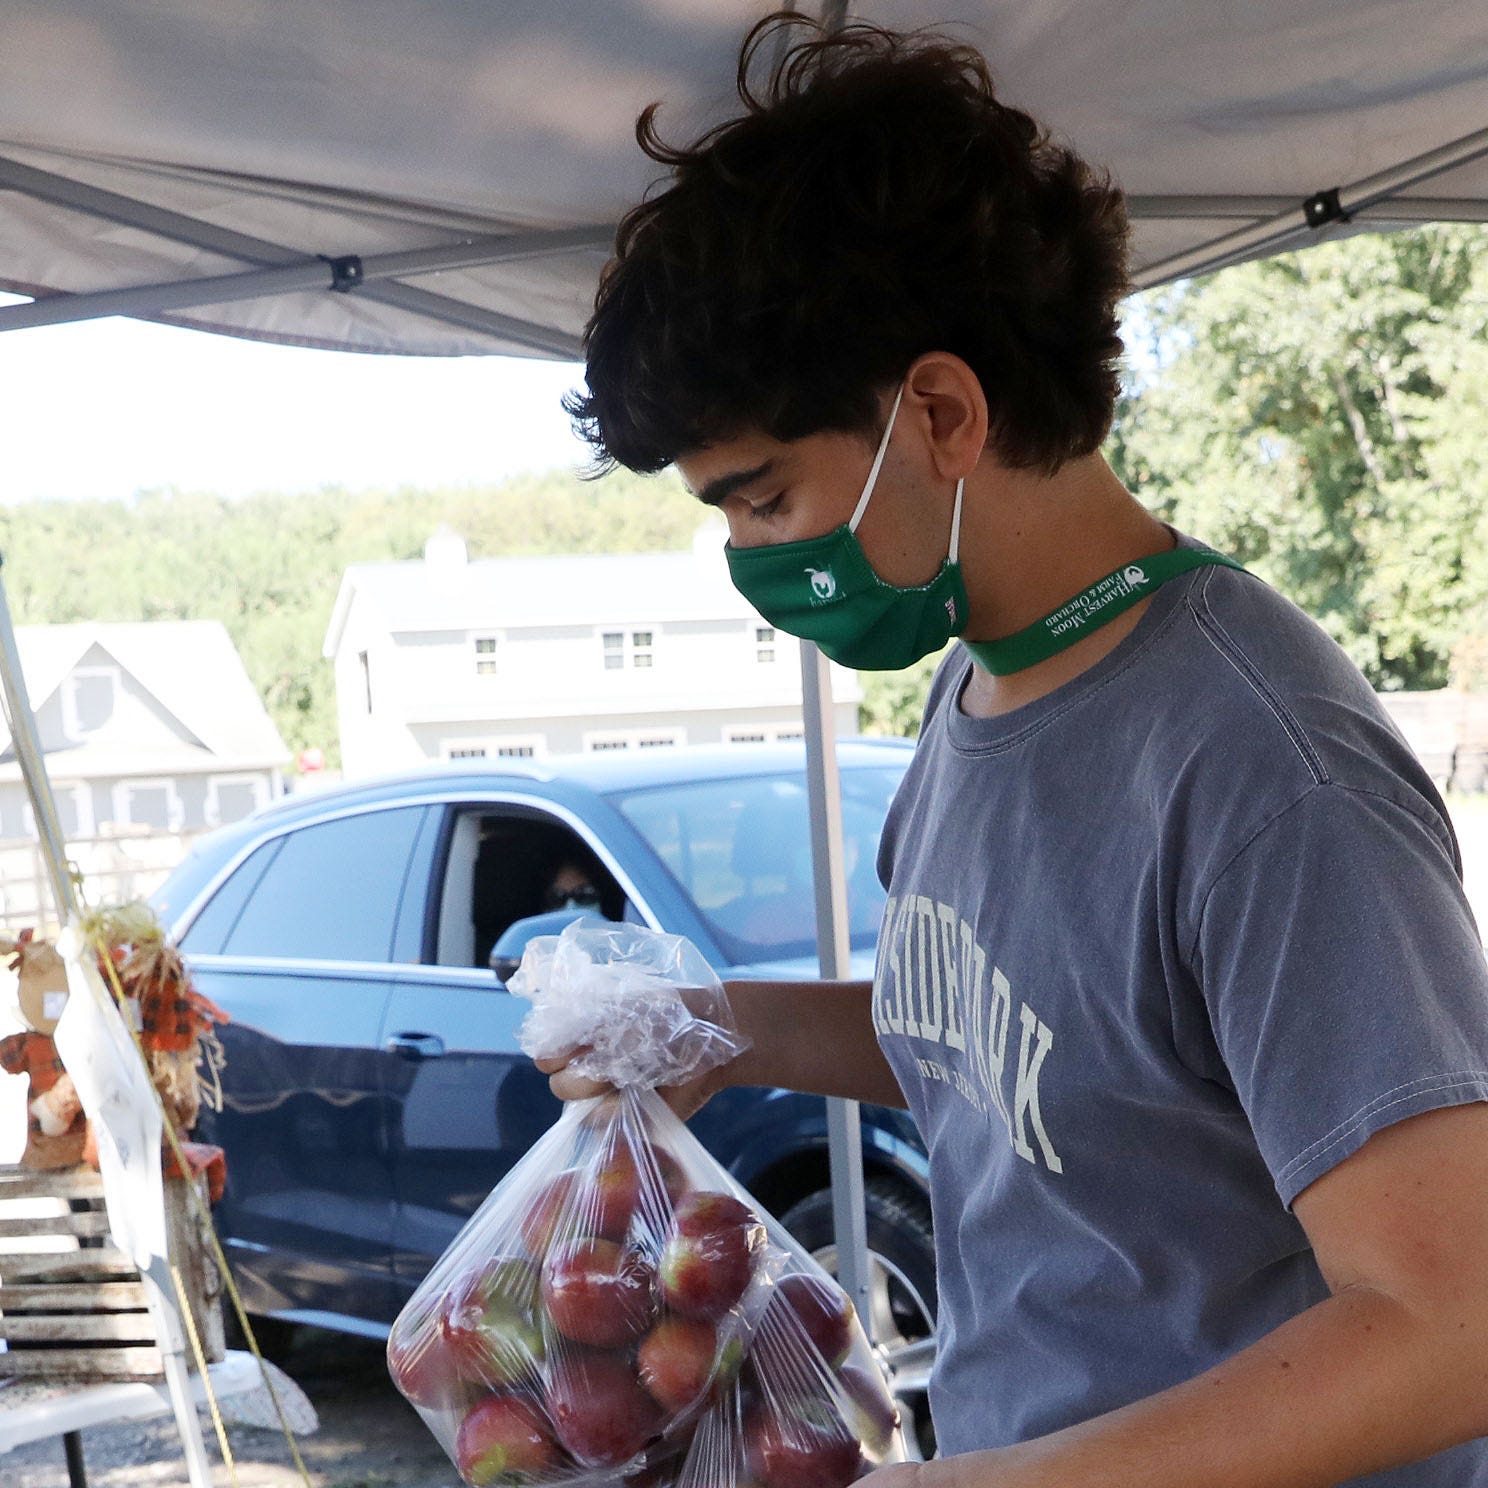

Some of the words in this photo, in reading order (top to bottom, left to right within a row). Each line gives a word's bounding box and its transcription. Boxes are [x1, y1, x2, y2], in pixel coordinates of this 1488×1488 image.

[1096, 572, 1123, 592] FARM
[1044, 594, 1090, 627] ORCHARD
[1082, 581, 1131, 616] HARVEST
[1050, 612, 1085, 637] MOON
[916, 1058, 951, 1085] NEW
